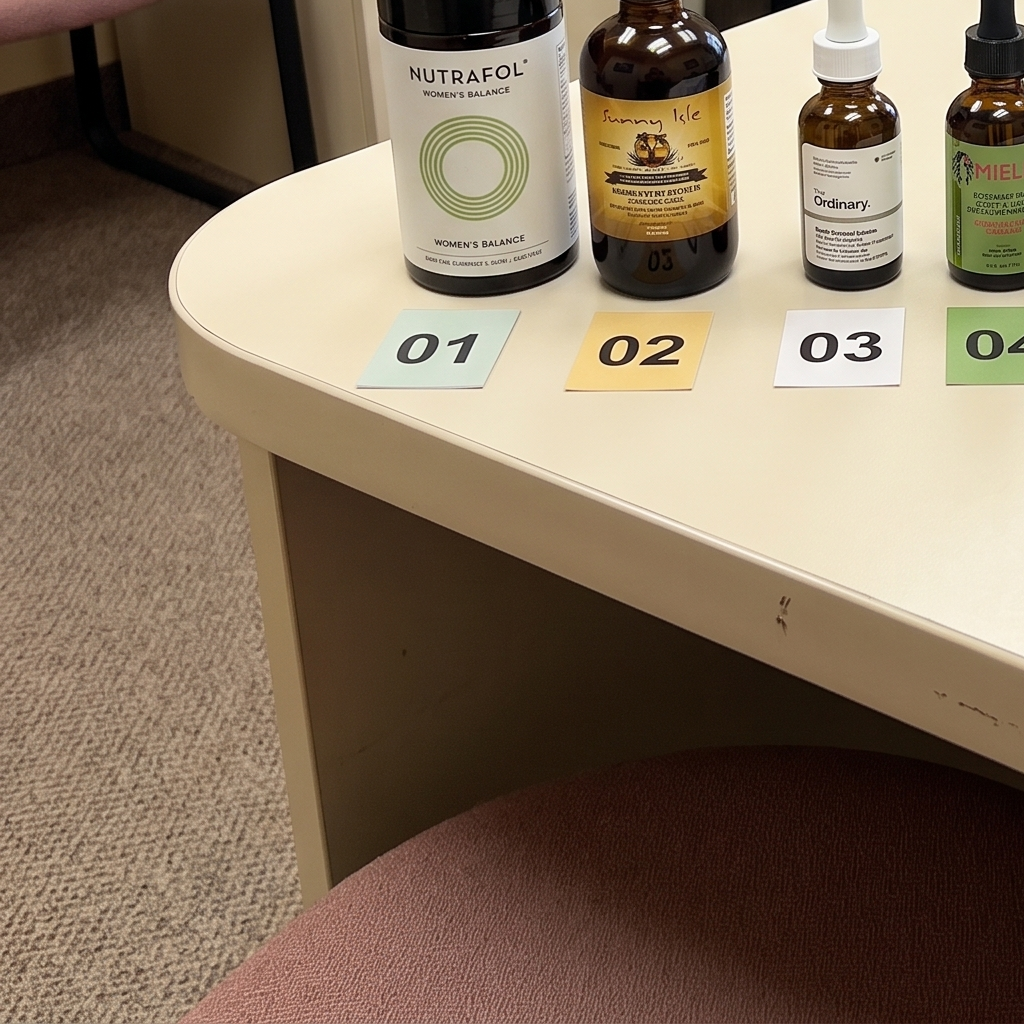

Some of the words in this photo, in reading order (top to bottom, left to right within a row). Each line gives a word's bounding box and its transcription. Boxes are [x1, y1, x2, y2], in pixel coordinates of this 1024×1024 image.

[422, 89, 465, 99] WOMEN'S
[467, 86, 511, 98] BALANCE
[602, 109, 663, 133] Sunny
[672, 104, 702, 125] Isle
[813, 194, 871, 212] Ordinary.
[433, 238, 479, 249] WOMEN'S
[481, 234, 526, 249] BALANCE
[396, 332, 480, 365] 01
[598, 334, 685, 367] 02
[799, 331, 883, 364] 03
